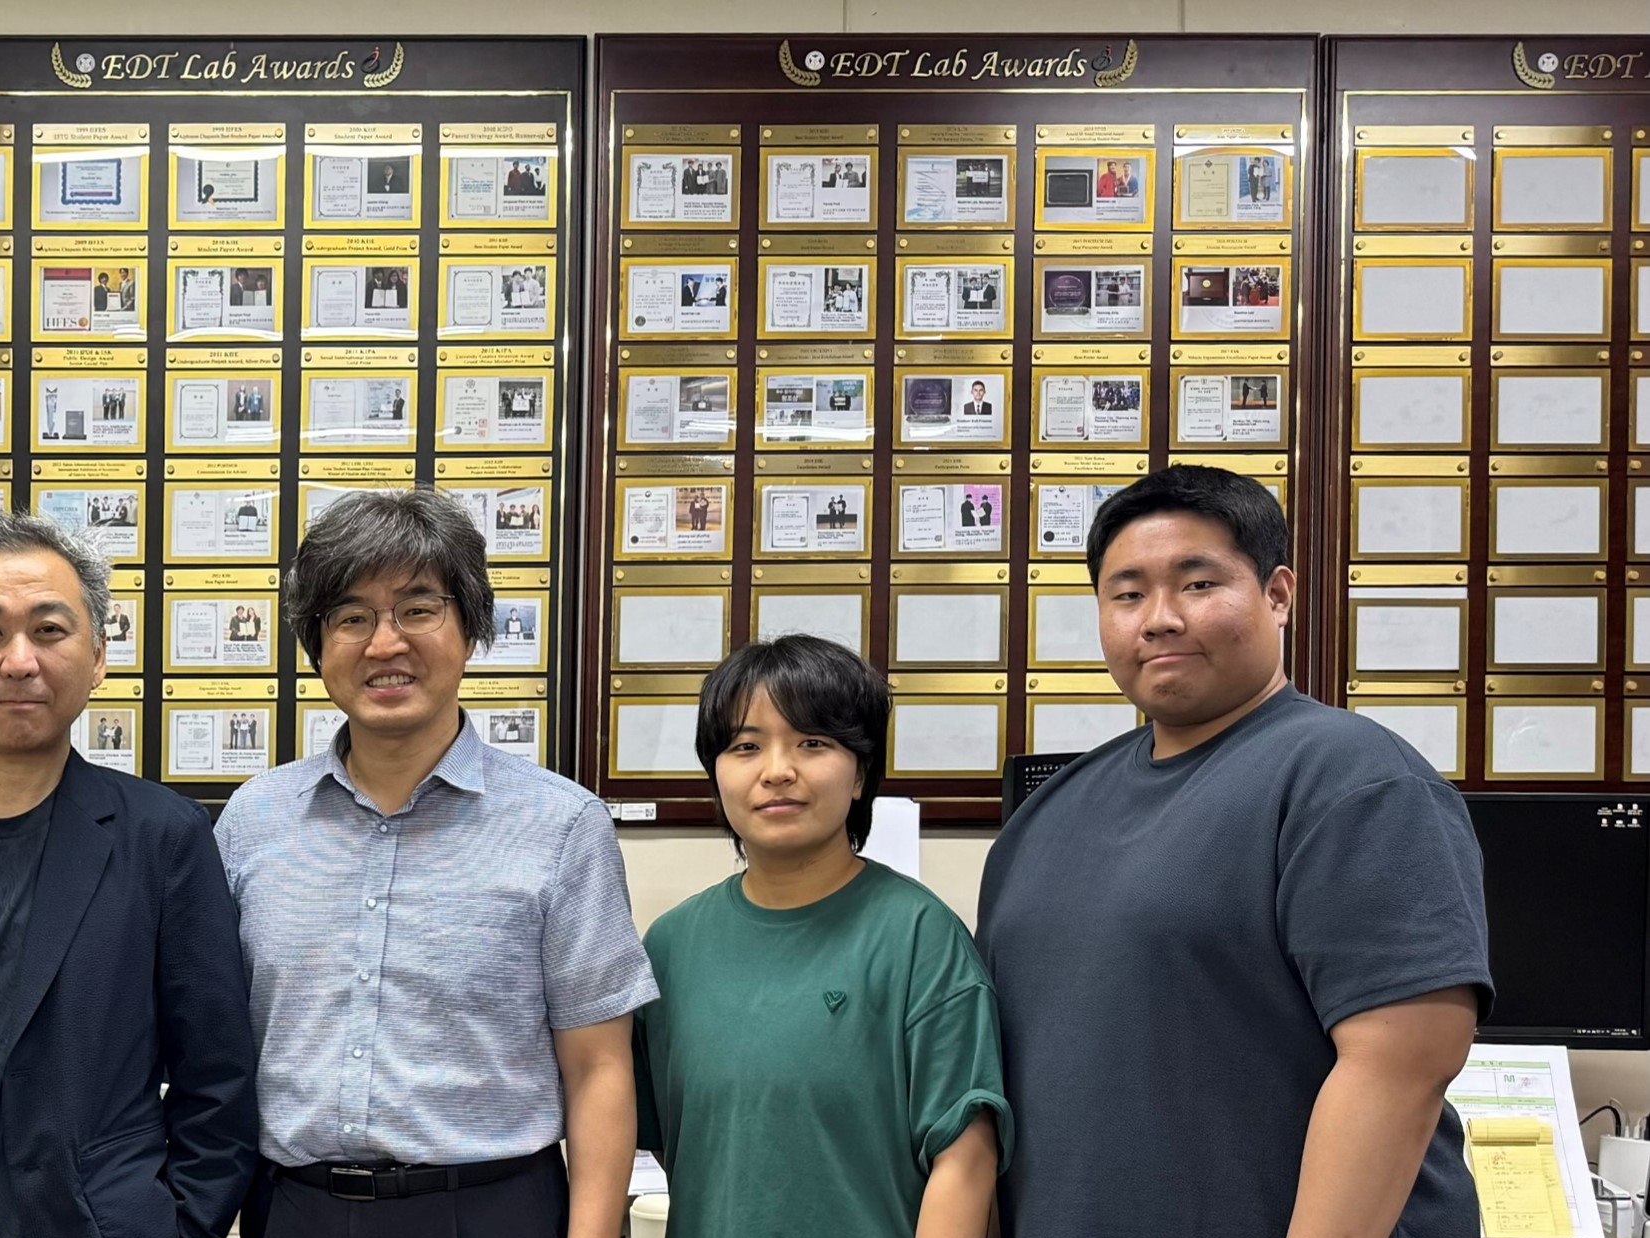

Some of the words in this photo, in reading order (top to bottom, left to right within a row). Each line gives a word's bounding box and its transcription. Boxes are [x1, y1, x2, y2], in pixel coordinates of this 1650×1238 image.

[100, 53, 177, 80] EDT
[179, 51, 236, 79] Lab
[240, 51, 354, 83] Awards
[828, 50, 908, 77] EDT
[910, 48, 966, 77] Lab
[970, 49, 1086, 79] Awards
[1563, 51, 1643, 79] EDT
